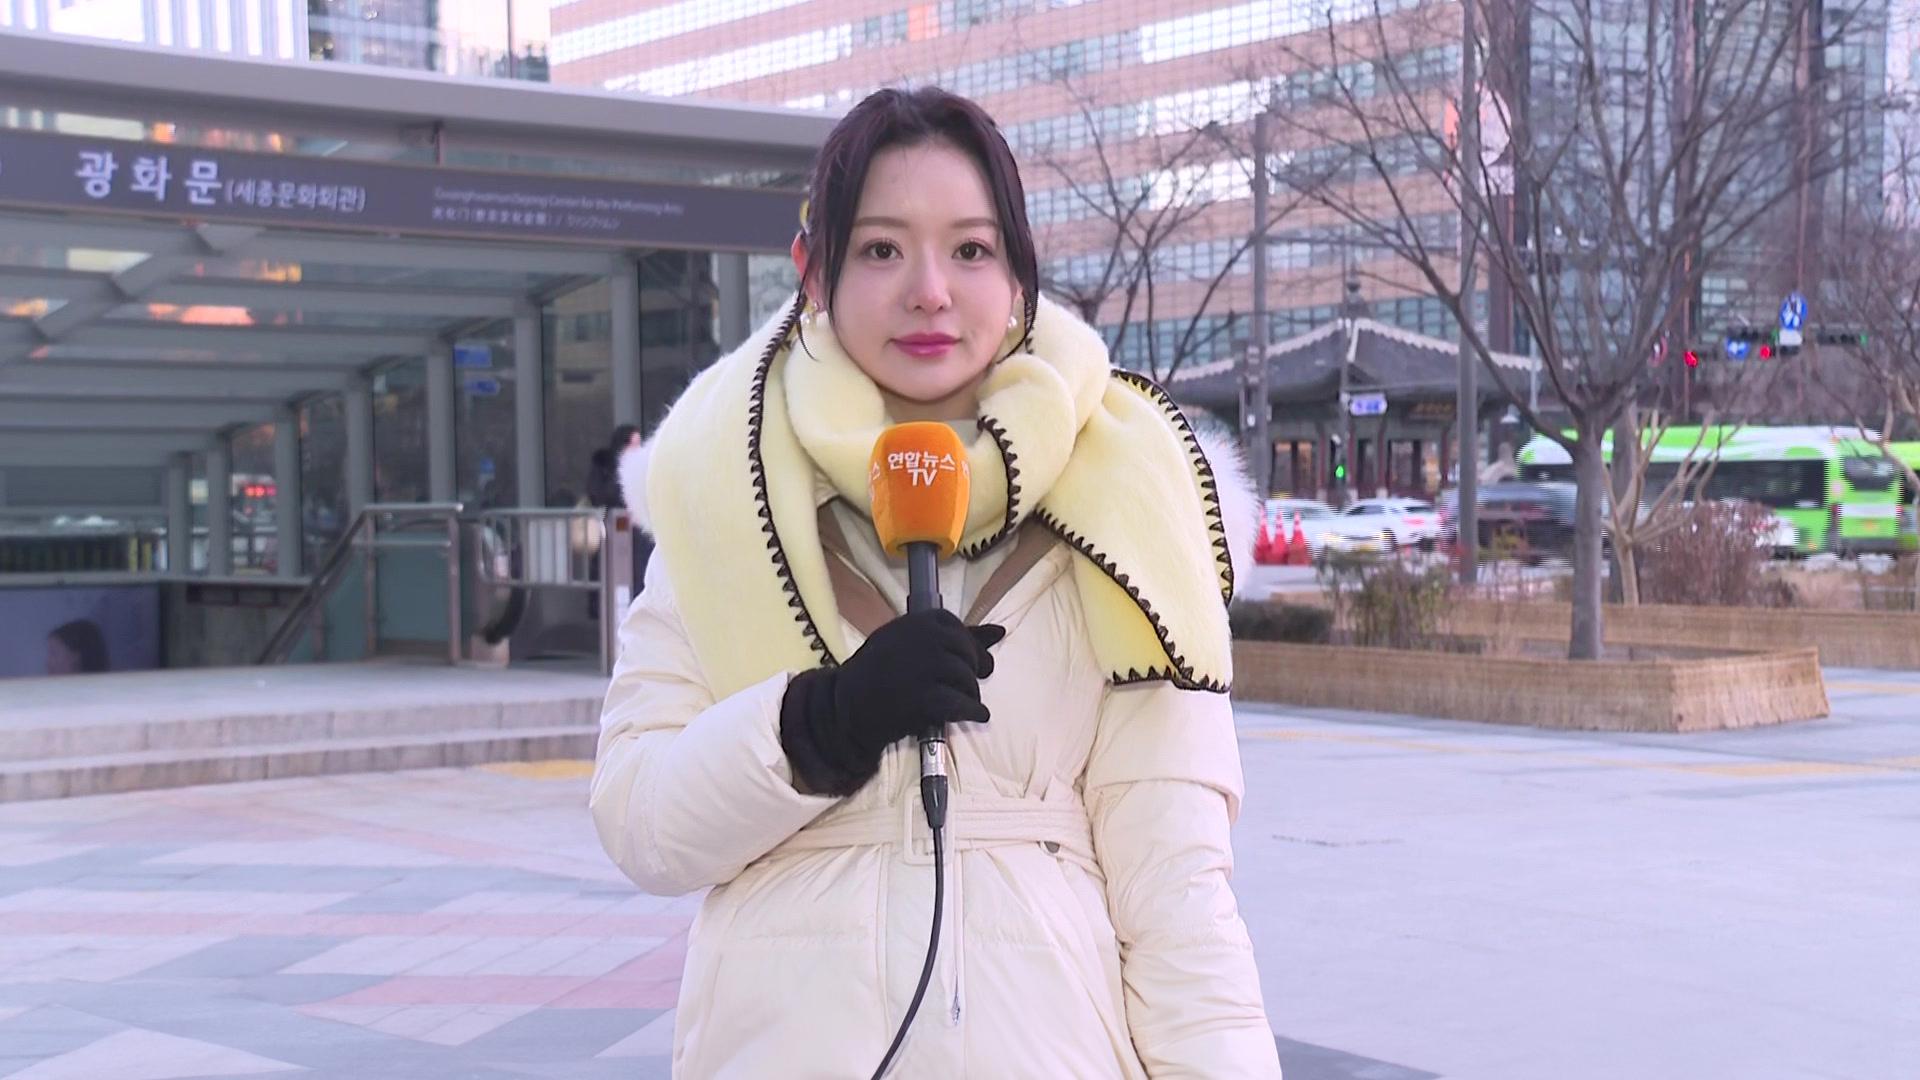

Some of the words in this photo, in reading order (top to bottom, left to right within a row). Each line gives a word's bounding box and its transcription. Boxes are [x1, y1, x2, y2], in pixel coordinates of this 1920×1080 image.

[75, 150, 223, 205] 광화문
[888, 451, 955, 471] 연합뉴스
[907, 468, 937, 487] TV
